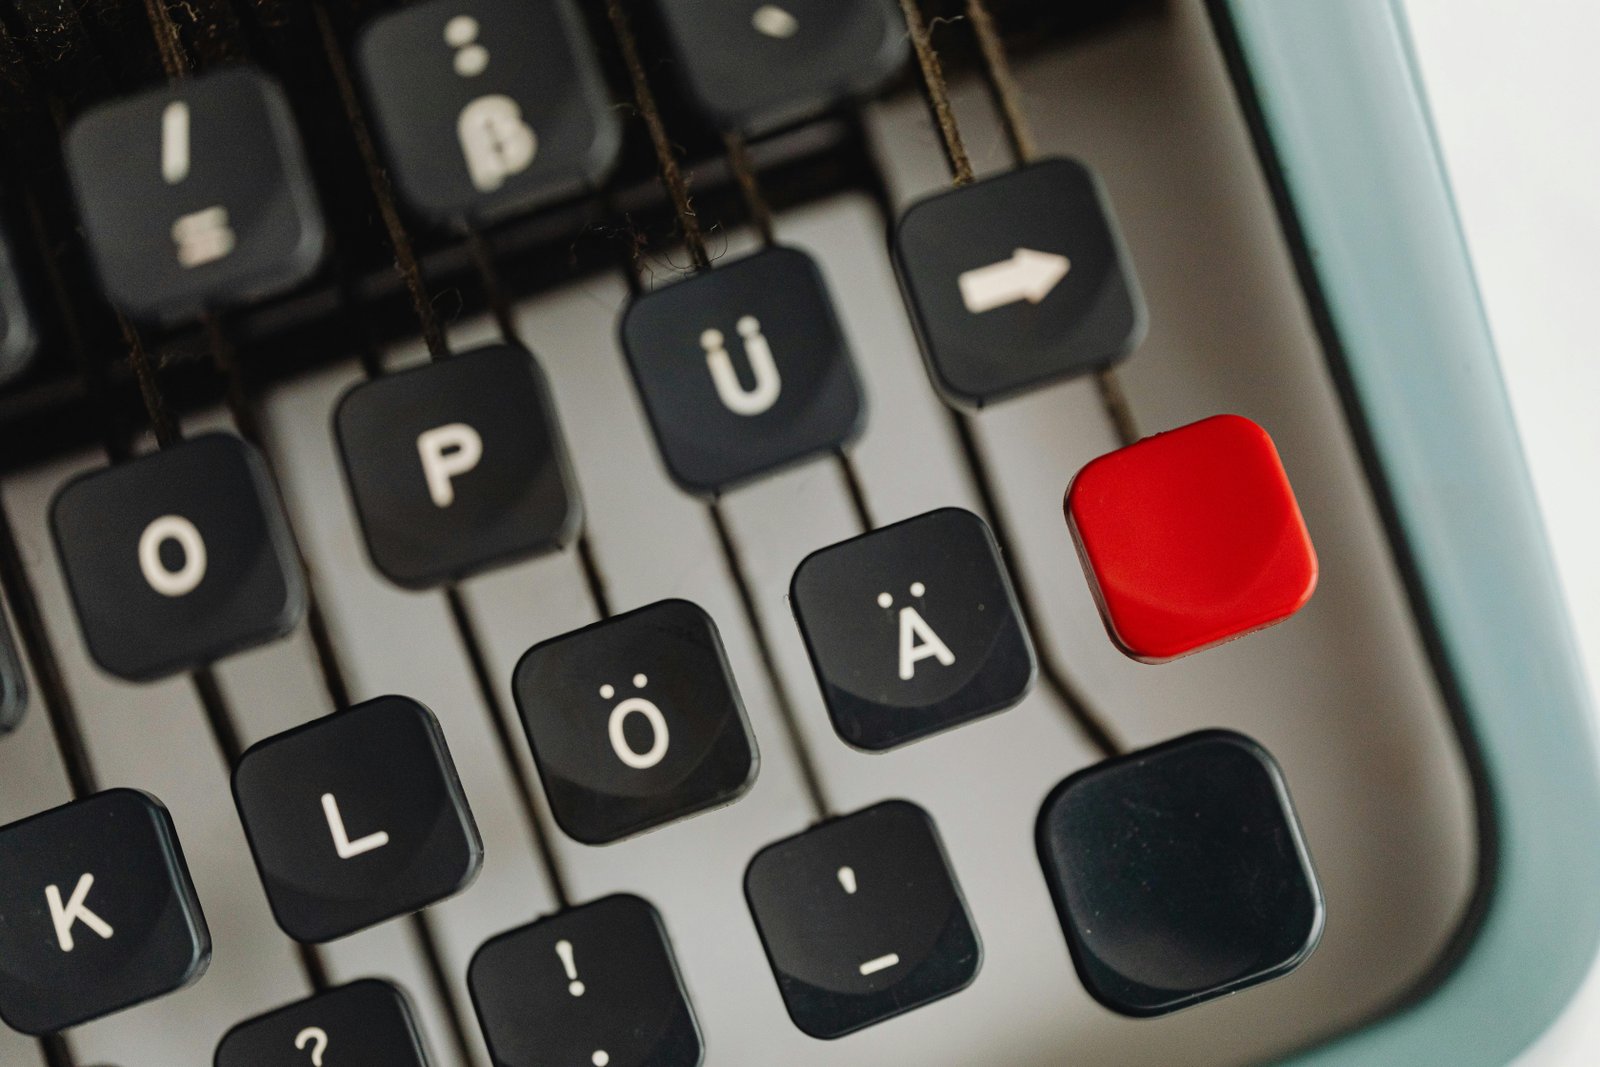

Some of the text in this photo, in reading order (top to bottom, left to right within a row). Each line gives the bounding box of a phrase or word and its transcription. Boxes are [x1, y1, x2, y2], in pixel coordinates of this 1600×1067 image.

[701, 316, 781, 415] Ü
[418, 424, 482, 506] P
[138, 516, 206, 595] O
[877, 582, 956, 681] Ä
[599, 673, 669, 769] Ö
[321, 792, 389, 859] L
[45, 873, 114, 952] K
[555, 940, 585, 997] !
